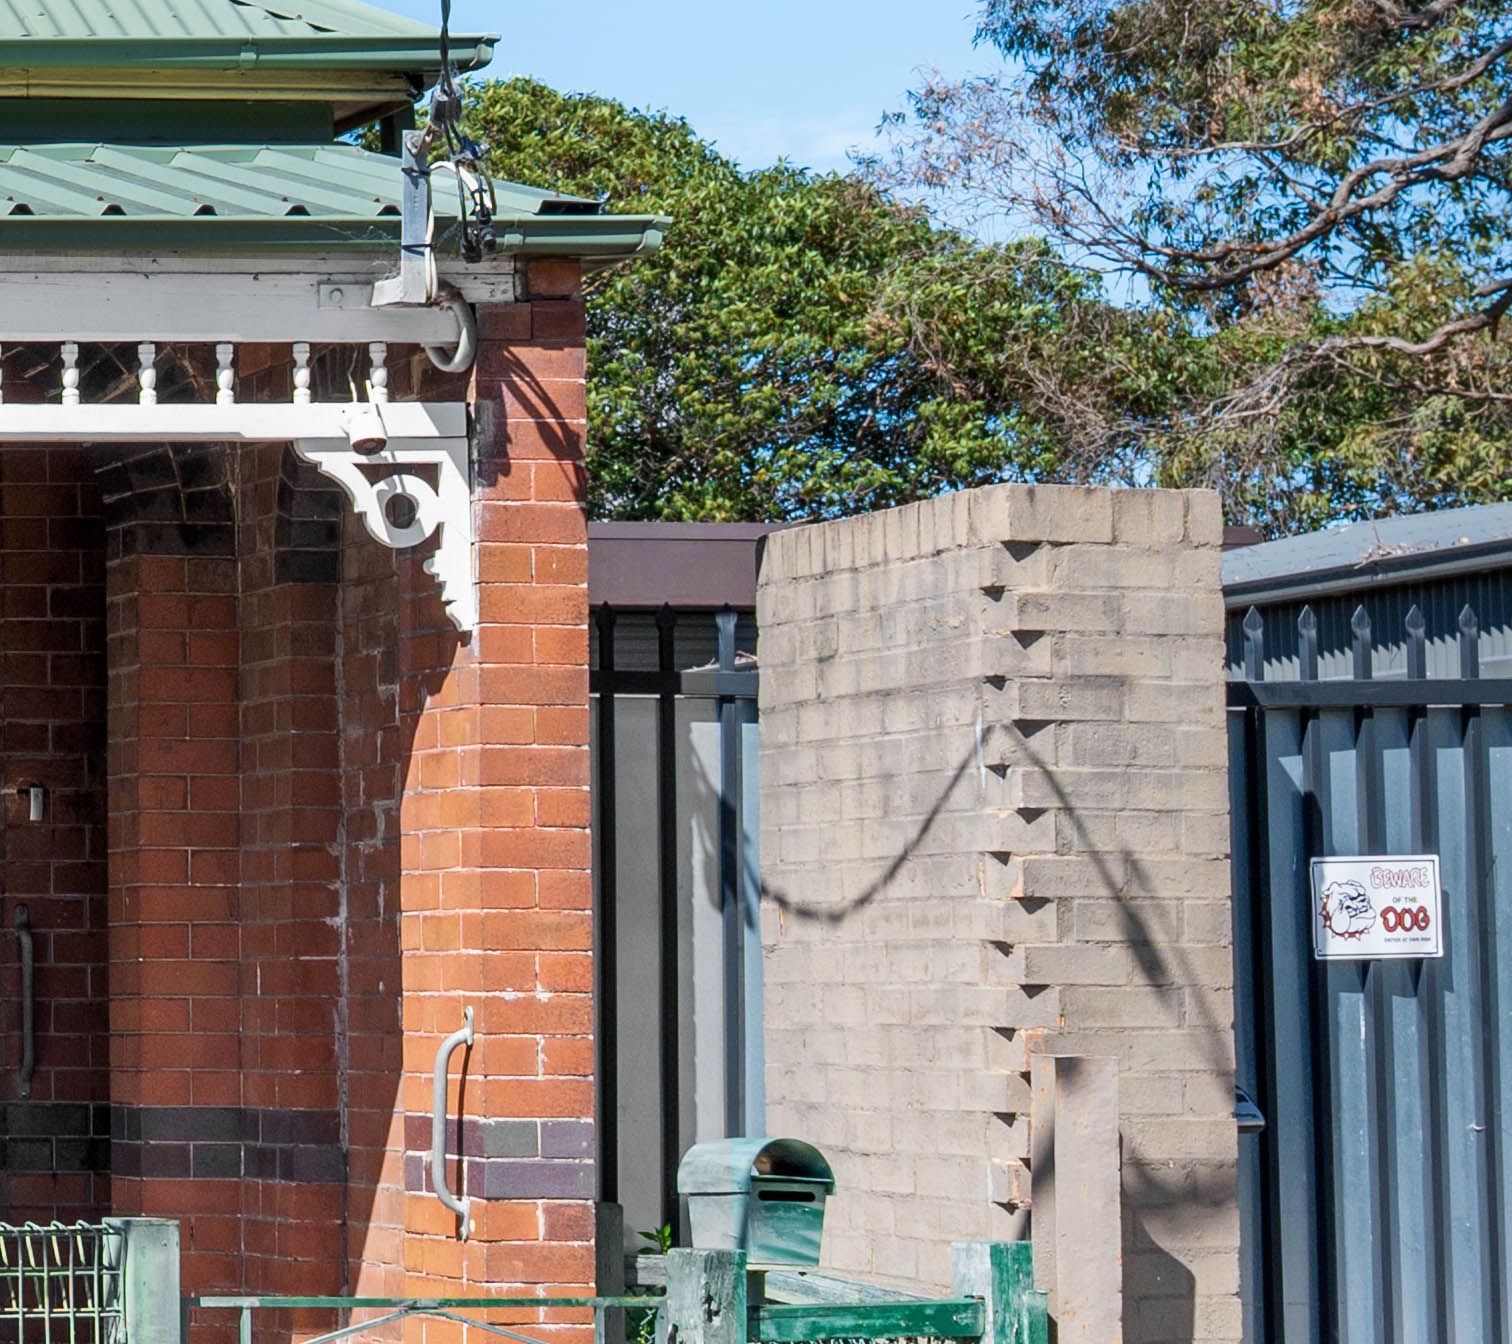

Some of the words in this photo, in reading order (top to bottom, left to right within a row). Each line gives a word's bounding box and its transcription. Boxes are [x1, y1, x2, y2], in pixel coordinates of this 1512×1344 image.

[1370, 866, 1431, 889] BEWARE
[1392, 896, 1401, 904] OF
[1404, 896, 1417, 904] THE
[1380, 905, 1431, 933] DOG
